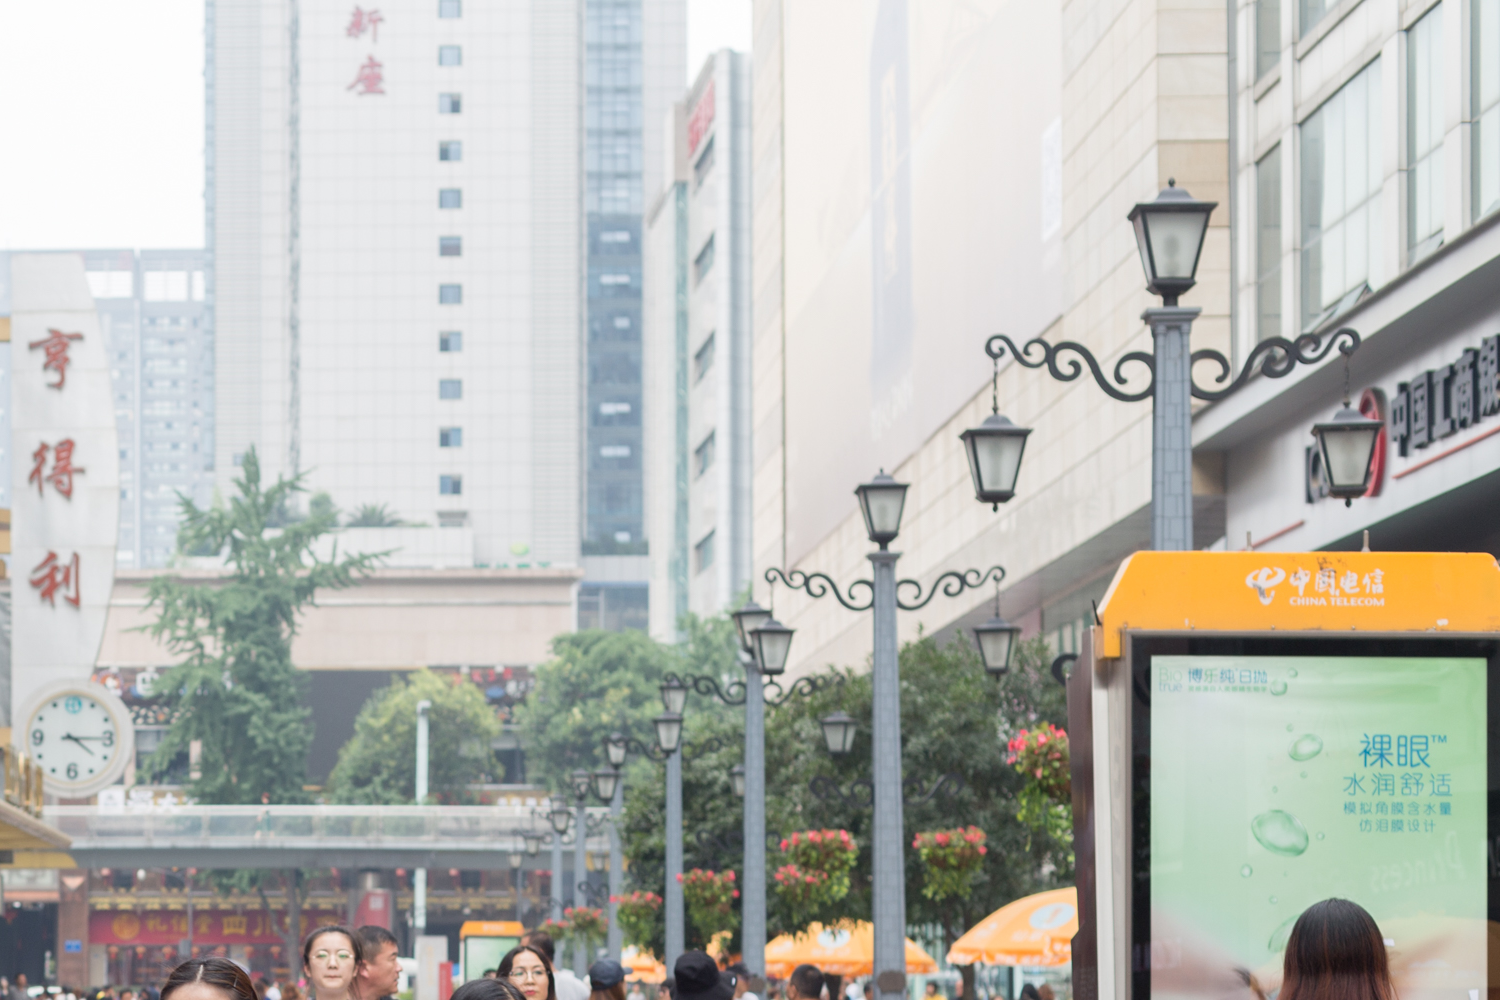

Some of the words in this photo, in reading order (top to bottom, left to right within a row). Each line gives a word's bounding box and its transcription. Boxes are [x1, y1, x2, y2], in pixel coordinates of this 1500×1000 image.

[28, 327, 86, 609] 亨得利
[1289, 566, 1385, 598] 中国电信
[1289, 596, 1328, 607] CHINA
[1329, 596, 1385, 607] TELECOM
[32, 729, 44, 747] 9
[102, 730, 114, 748] 3
[67, 763, 78, 780] 6
[1343, 772, 1453, 797] 水润舒适
[1343, 801, 1452, 816] 模拟角膜含水量
[1359, 818, 1437, 833] 仿泪膜设计
